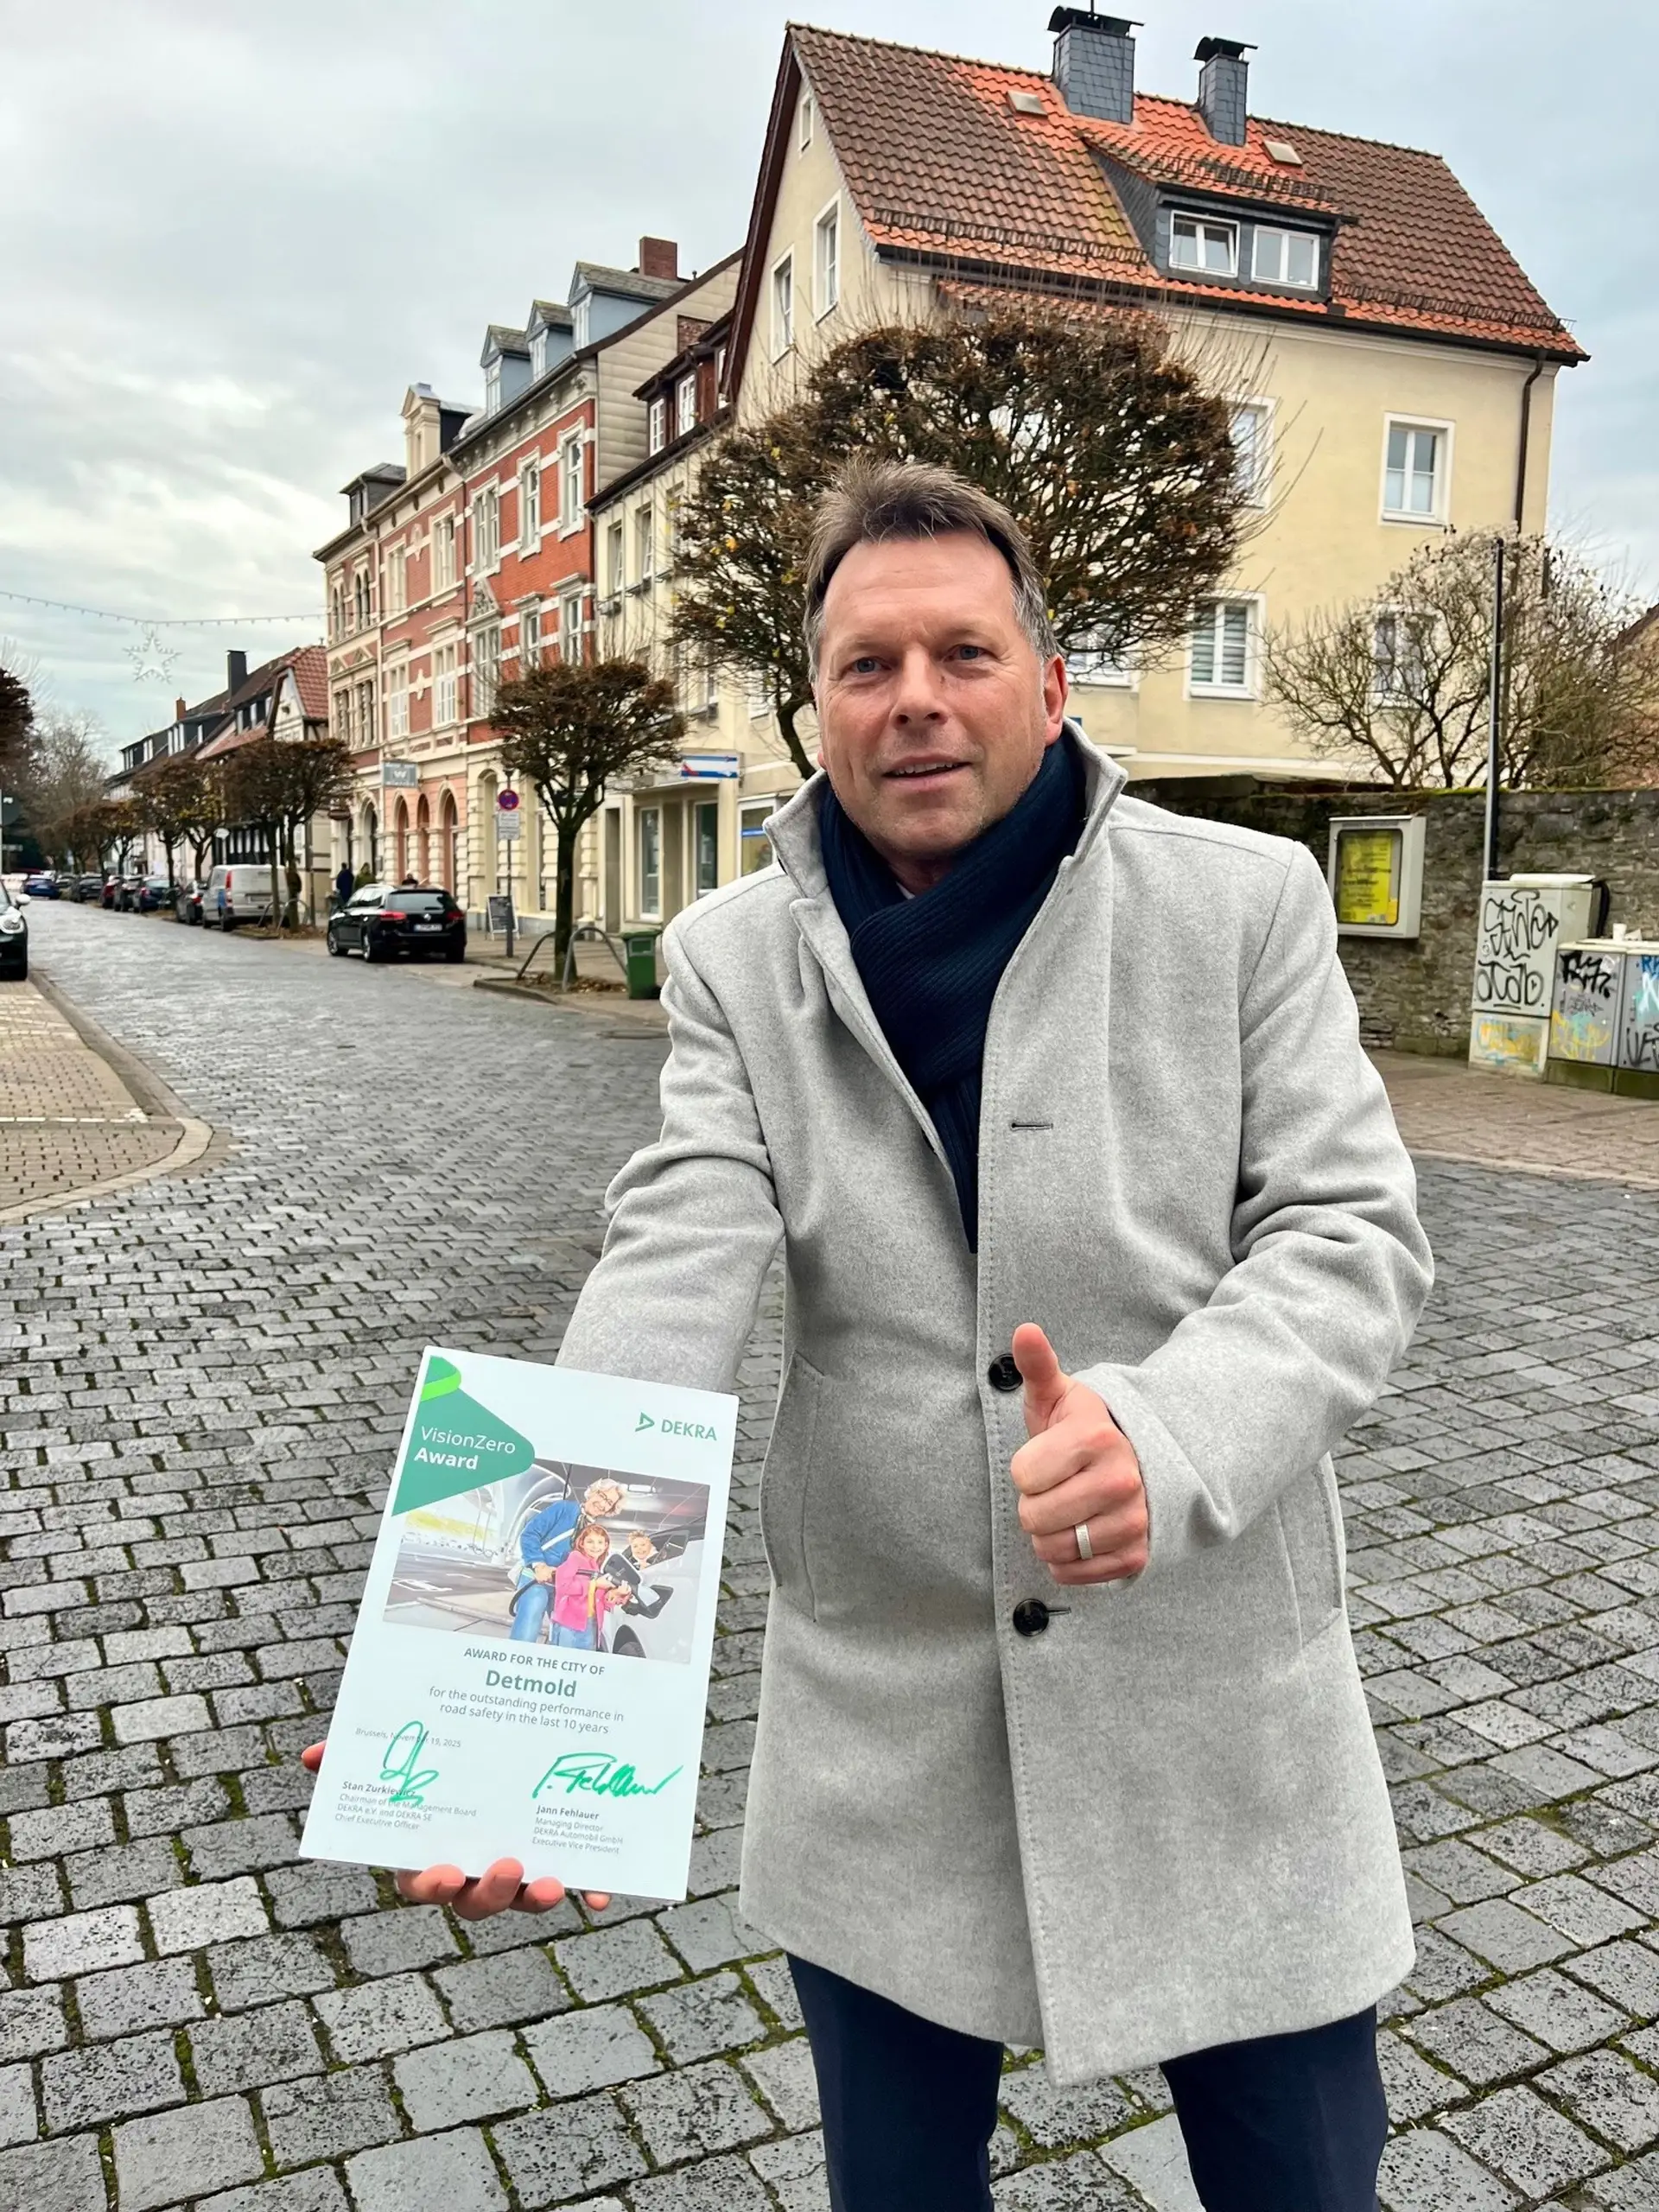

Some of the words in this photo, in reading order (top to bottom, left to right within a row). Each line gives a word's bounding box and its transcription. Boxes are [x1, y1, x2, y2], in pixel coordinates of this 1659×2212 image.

[421, 1426, 516, 1454] VisionZero
[661, 1419, 717, 1441] DEKRA
[414, 1447, 479, 1470] Award
[464, 1648, 507, 1662] AWARD
[510, 1654, 533, 1666] FOR
[537, 1657, 558, 1669] THE
[561, 1661, 588, 1673] CITY
[589, 1665, 605, 1675] OF
[486, 1669, 577, 1697] Detmold
[429, 1686, 446, 1697] for
[448, 1689, 467, 1700] the
[469, 1694, 537, 1713] outstanding
[539, 1703, 611, 1720] performance
[613, 1710, 624, 1722] in
[440, 1704, 467, 1715] road
[469, 1707, 503, 1722] safety
[505, 1711, 517, 1722] in
[519, 1713, 537, 1725] the
[539, 1714, 560, 1728] last
[563, 1719, 576, 1730] 10
[578, 1722, 609, 1734] years
[342, 1781, 363, 1791] Stan
[536, 1804, 557, 1815] Jann
[559, 1808, 600, 1820] Fehlauer
